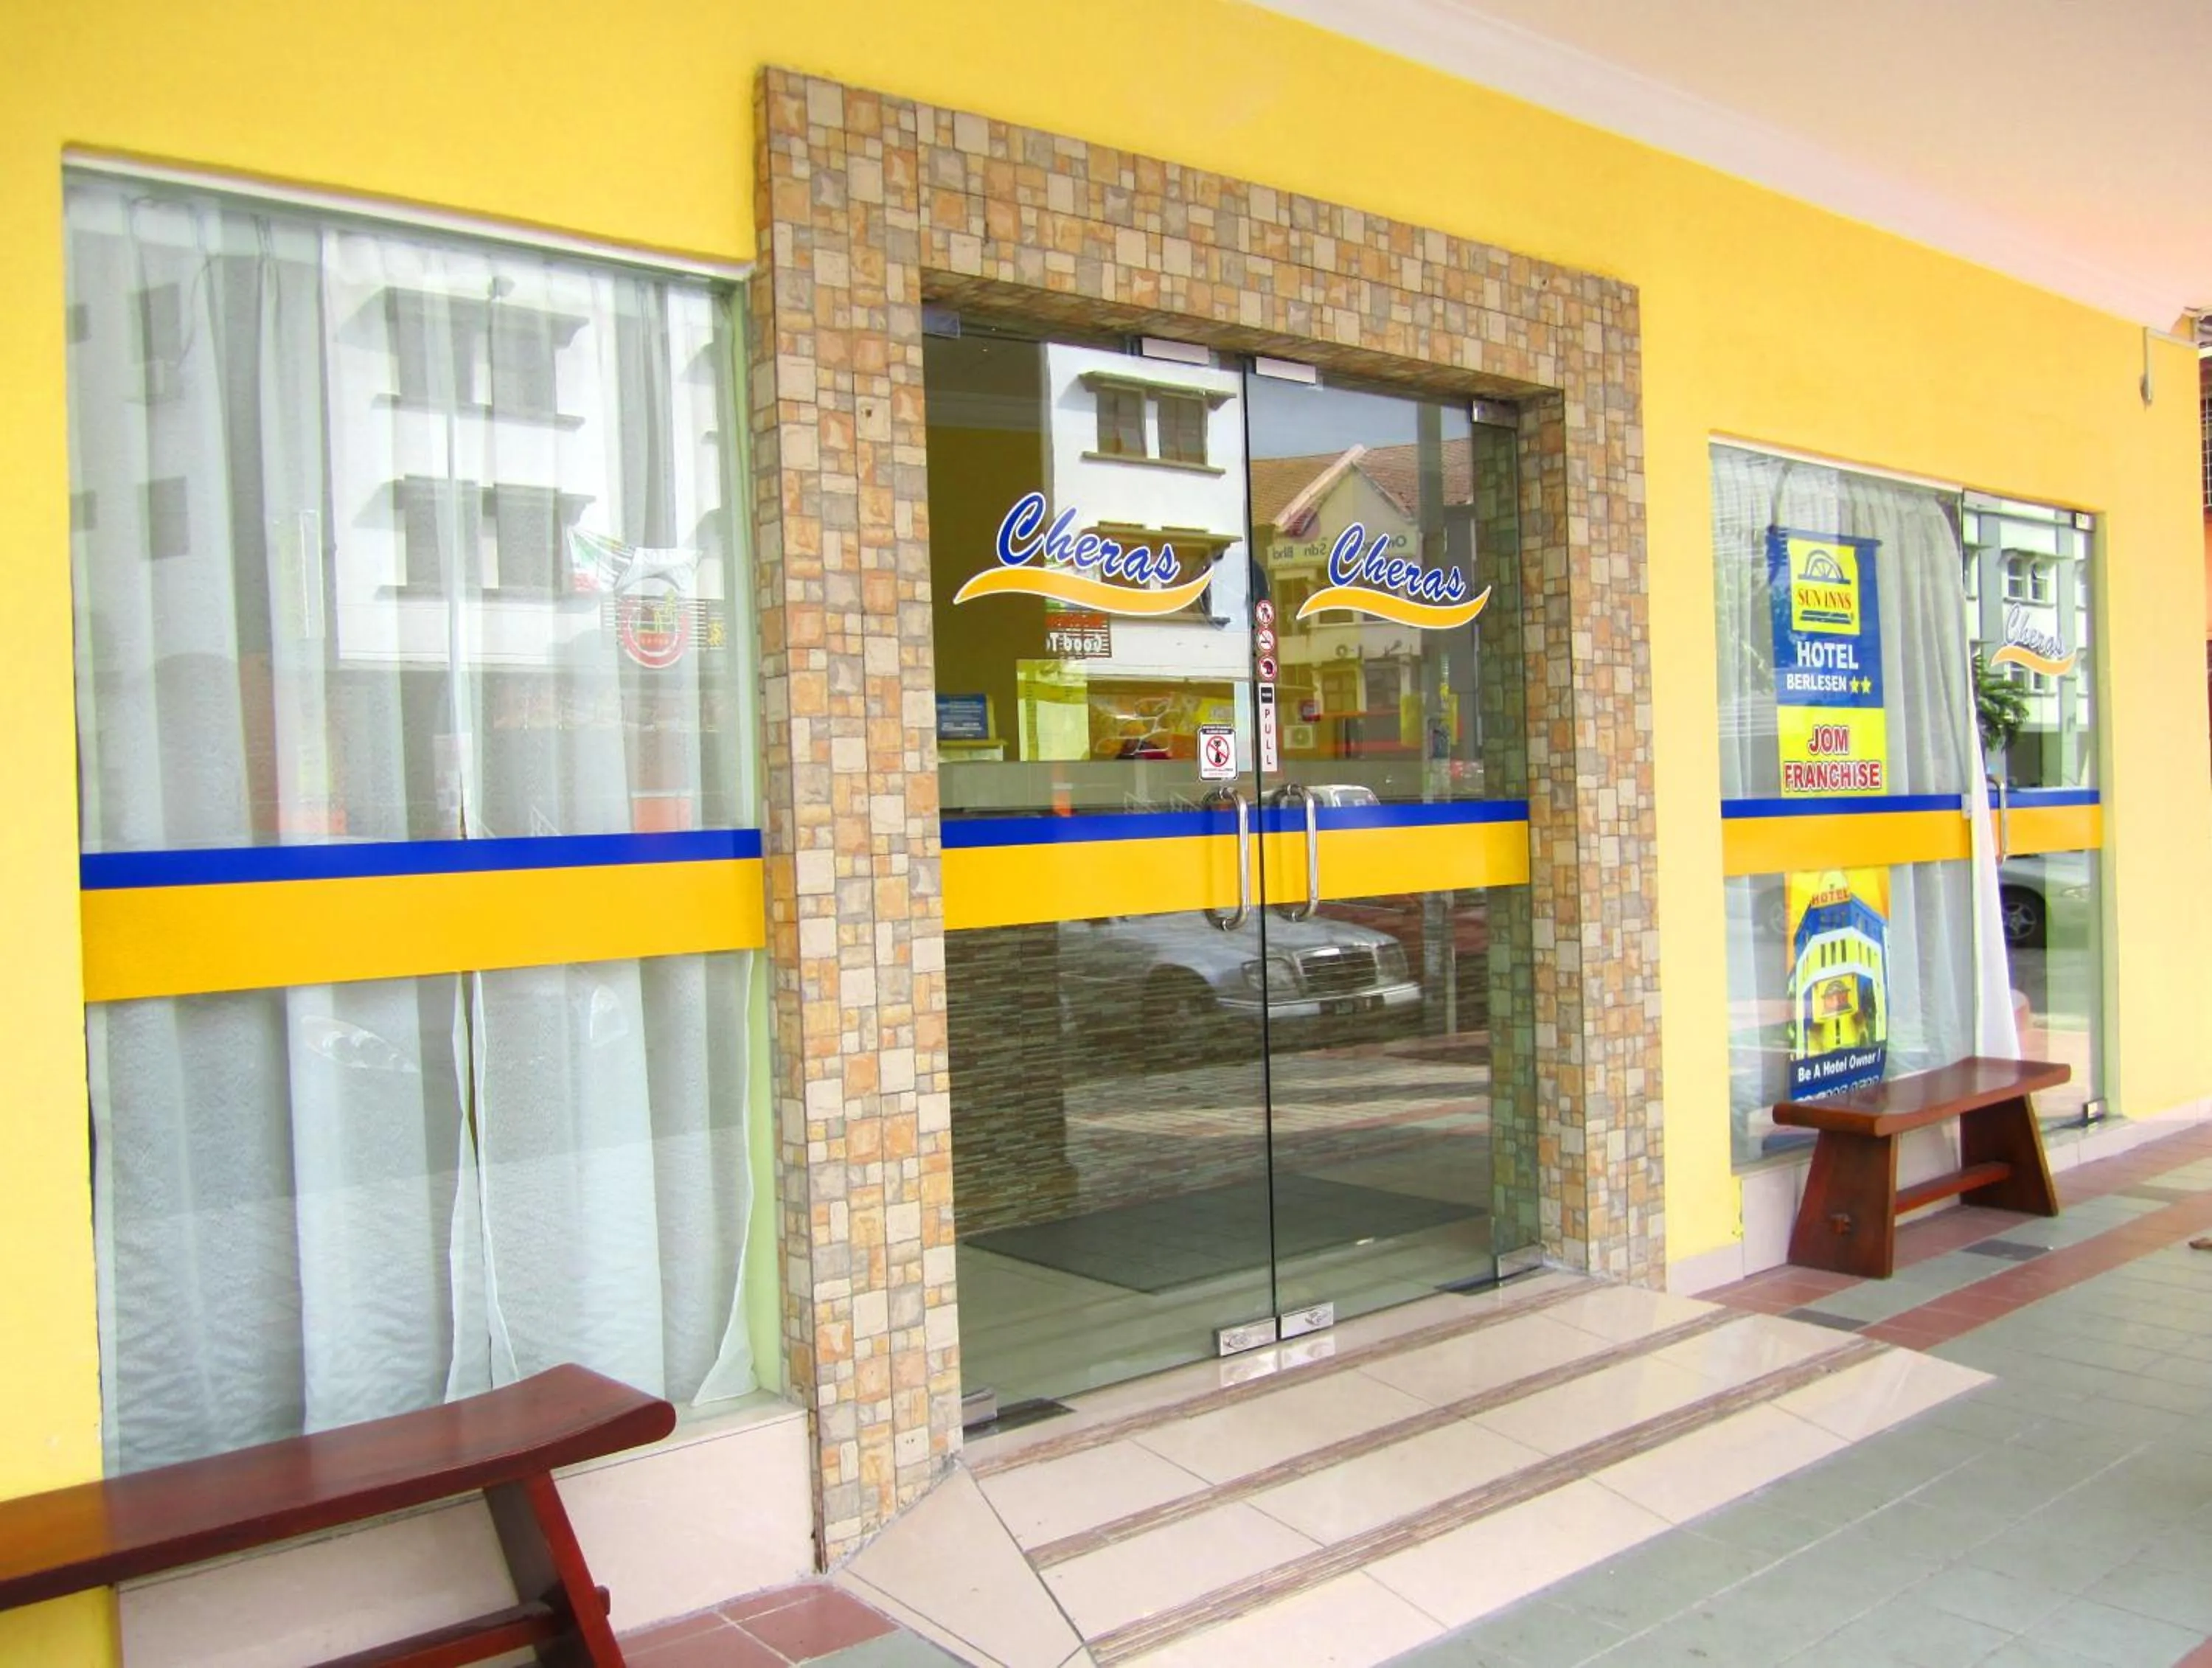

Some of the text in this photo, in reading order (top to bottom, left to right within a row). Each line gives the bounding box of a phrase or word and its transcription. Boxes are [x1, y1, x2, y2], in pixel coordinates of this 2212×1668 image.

[997, 492, 1180, 584] Cheras
[1329, 522, 1466, 602] Cheras
[1798, 588, 1851, 609] SUN INNS
[2005, 602, 2065, 658] Cheras
[1797, 641, 1859, 670] HOTEL
[1787, 673, 1847, 692] BERLESEN
[1264, 709, 1272, 765] PULL
[1808, 724, 1850, 756] JOM
[1783, 761, 1882, 792] FRANCHISE
[1812, 888, 1848, 905] HOTEL
[1798, 1066, 1812, 1083] Be
[1813, 1063, 1821, 1079] A
[1823, 1056, 1847, 1077] Hotel
[1848, 1052, 1877, 1069] Owner
